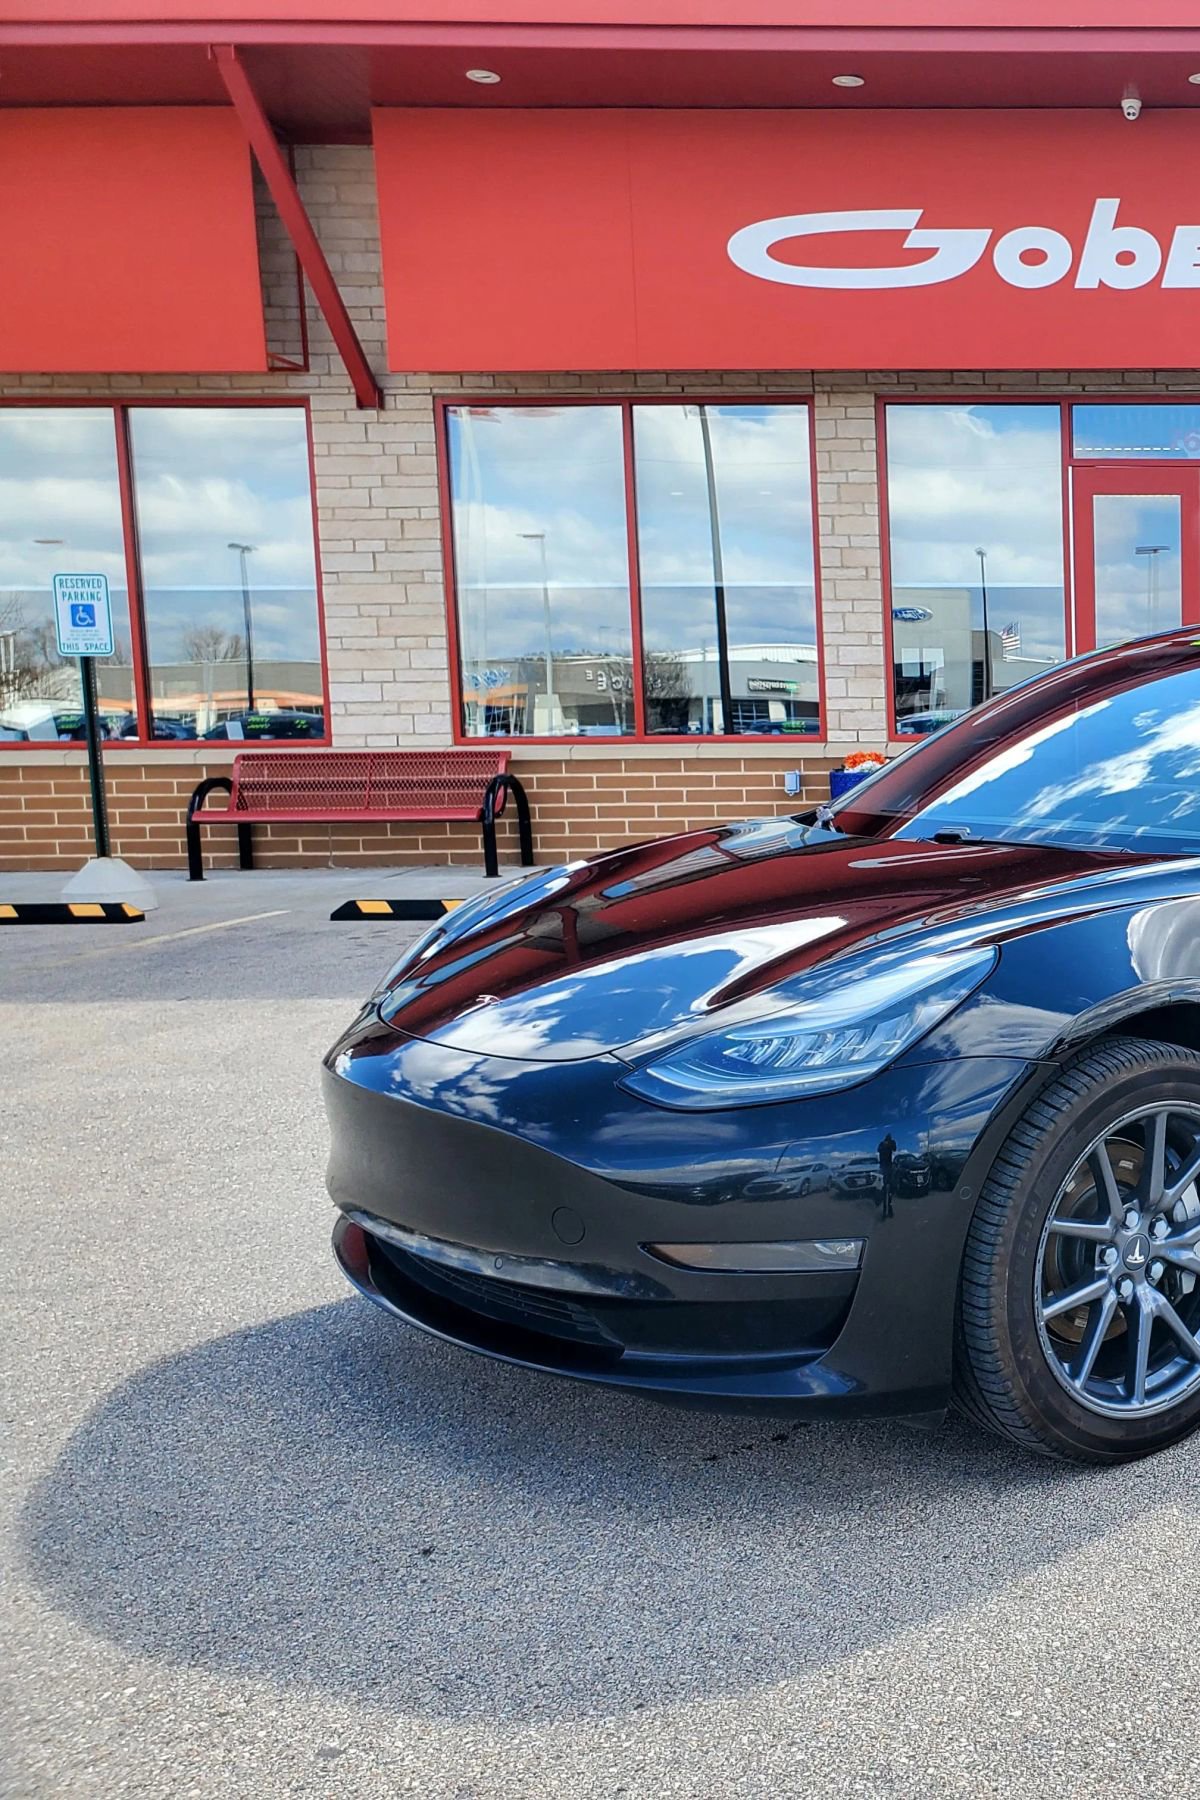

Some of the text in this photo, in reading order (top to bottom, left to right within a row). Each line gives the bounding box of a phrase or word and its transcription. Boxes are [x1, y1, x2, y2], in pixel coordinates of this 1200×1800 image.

[58, 578, 103, 589] RESERVED
[61, 591, 102, 602] PARKING
[62, 642, 109, 651] THIS SPACE
